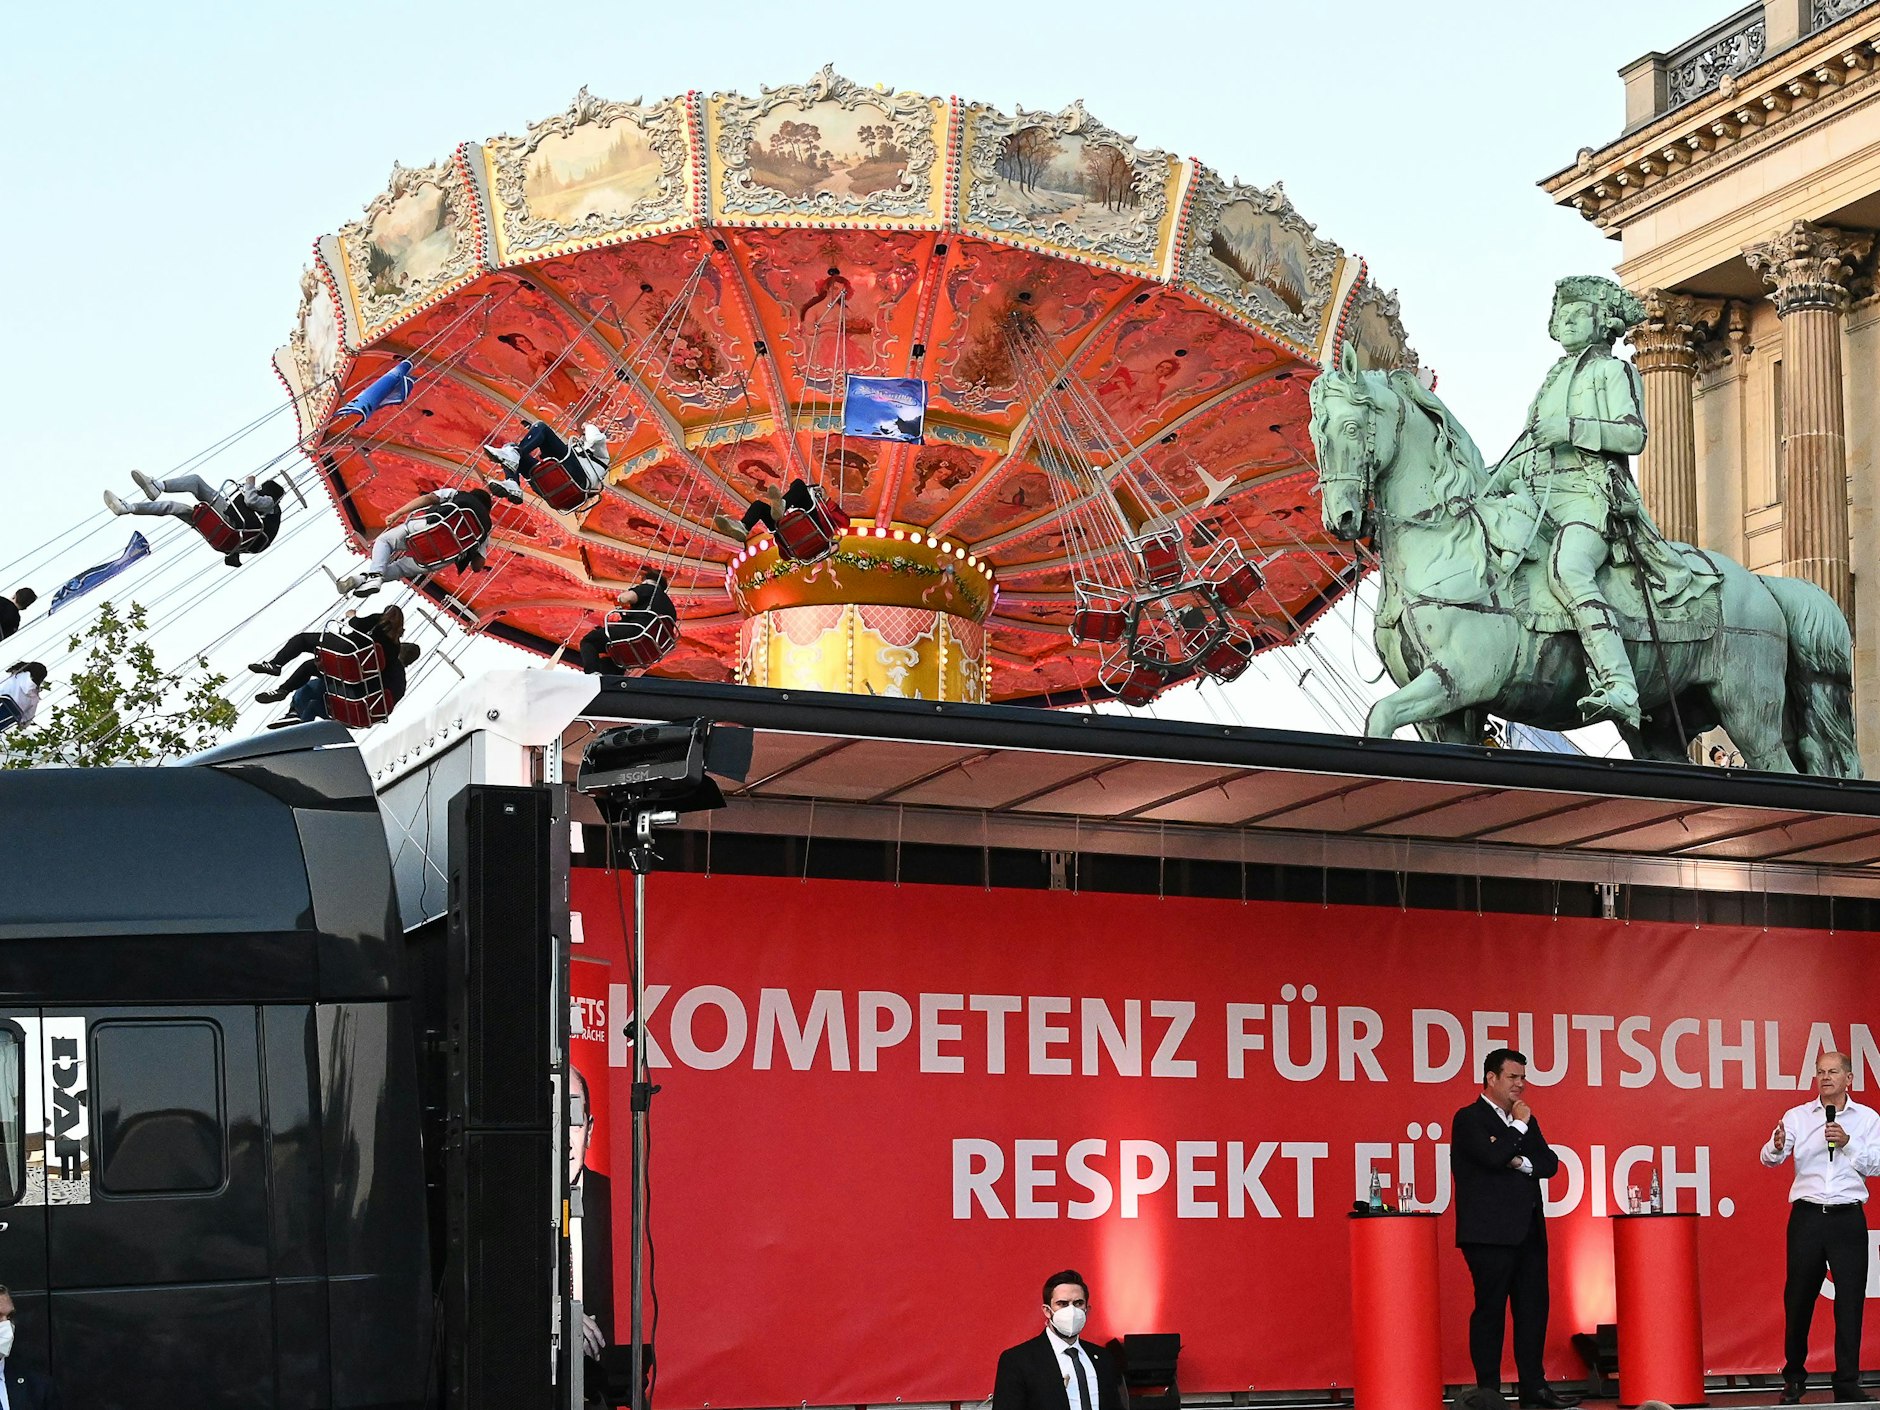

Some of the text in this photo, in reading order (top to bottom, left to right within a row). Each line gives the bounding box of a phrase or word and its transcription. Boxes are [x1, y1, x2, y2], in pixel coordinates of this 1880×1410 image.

[608, 983, 1197, 1078] KOMPETENZ
[1227, 983, 1388, 1083] FÜR
[51, 1037, 81, 1181] DAF
[951, 1121, 1735, 1221] RESPEKT FÜ DICH.
